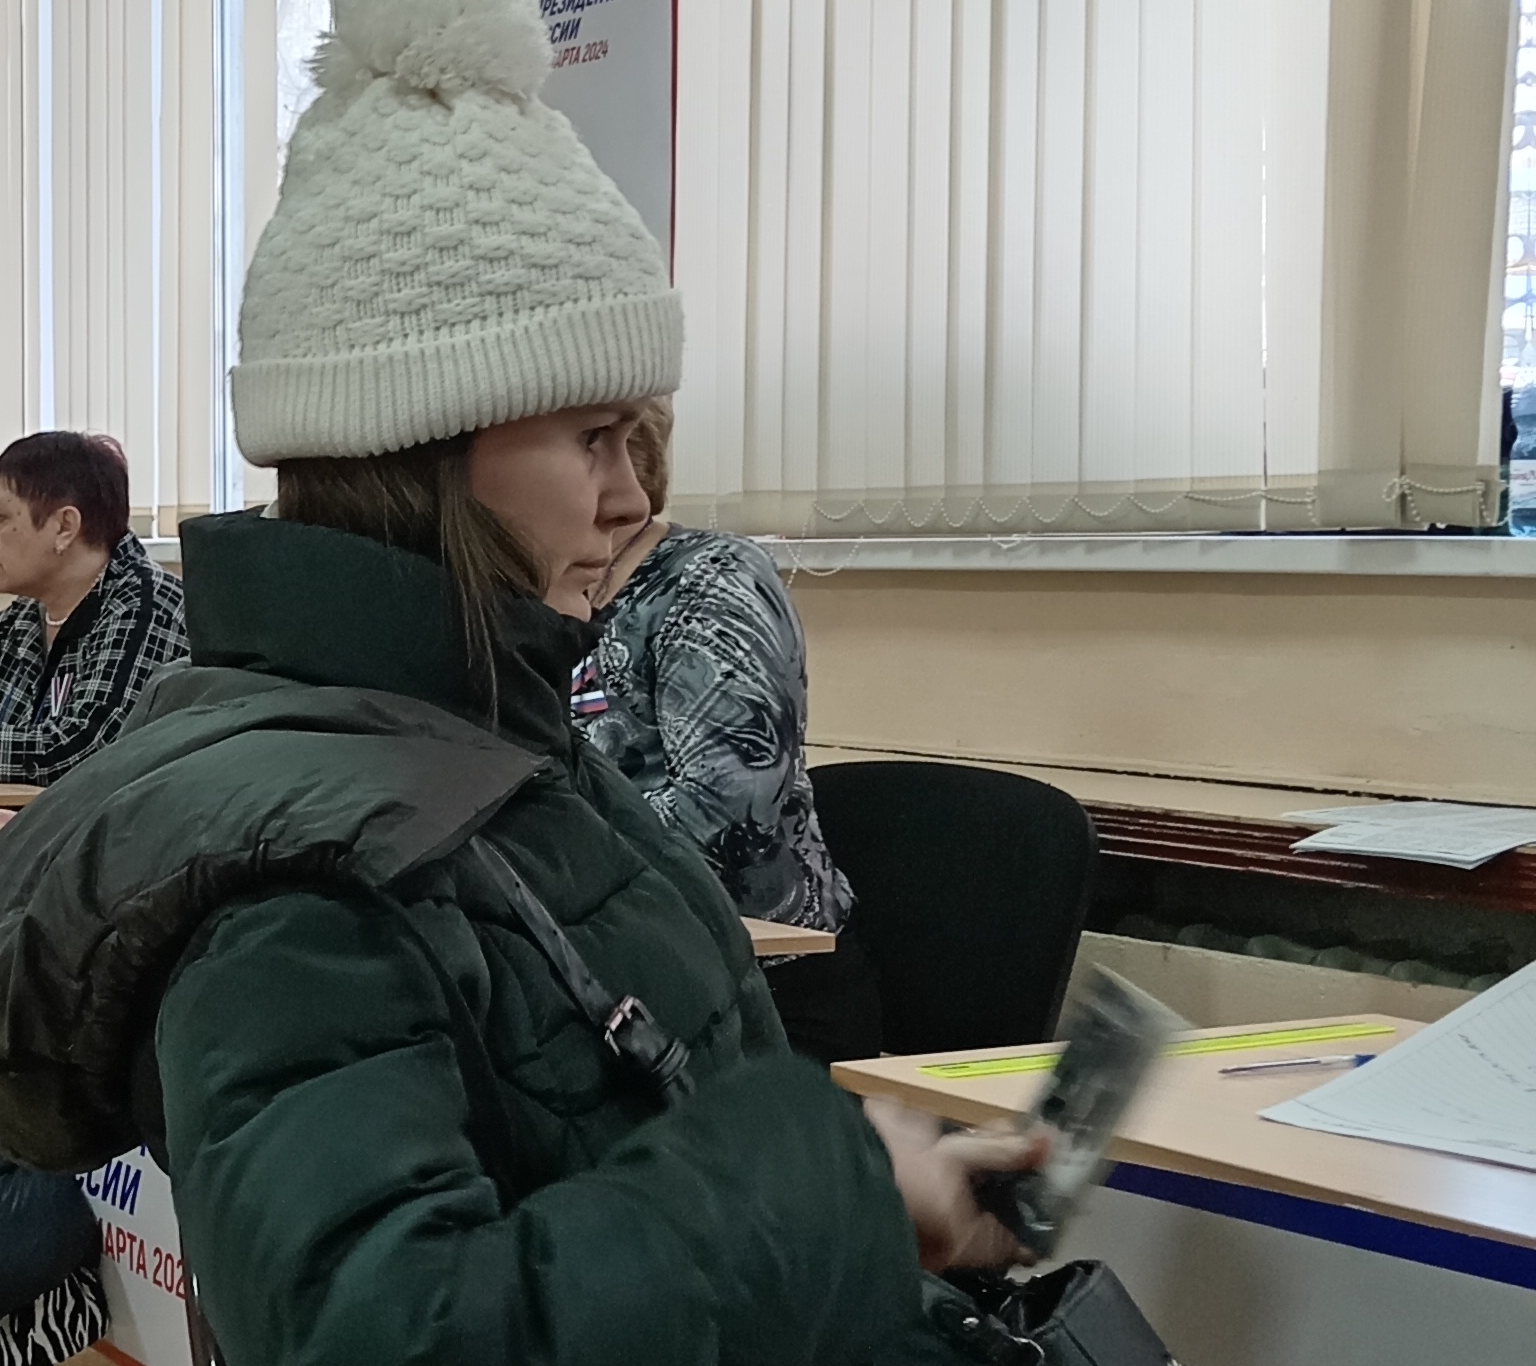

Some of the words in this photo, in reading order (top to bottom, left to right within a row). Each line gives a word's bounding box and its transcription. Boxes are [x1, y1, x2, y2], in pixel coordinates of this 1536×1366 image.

[549, 17, 582, 44] СИИ
[552, 46, 581, 68] АРТА
[582, 39, 609, 63] 2024
[96, 1218, 148, 1280] АРТА
[152, 1246, 186, 1301] 202
